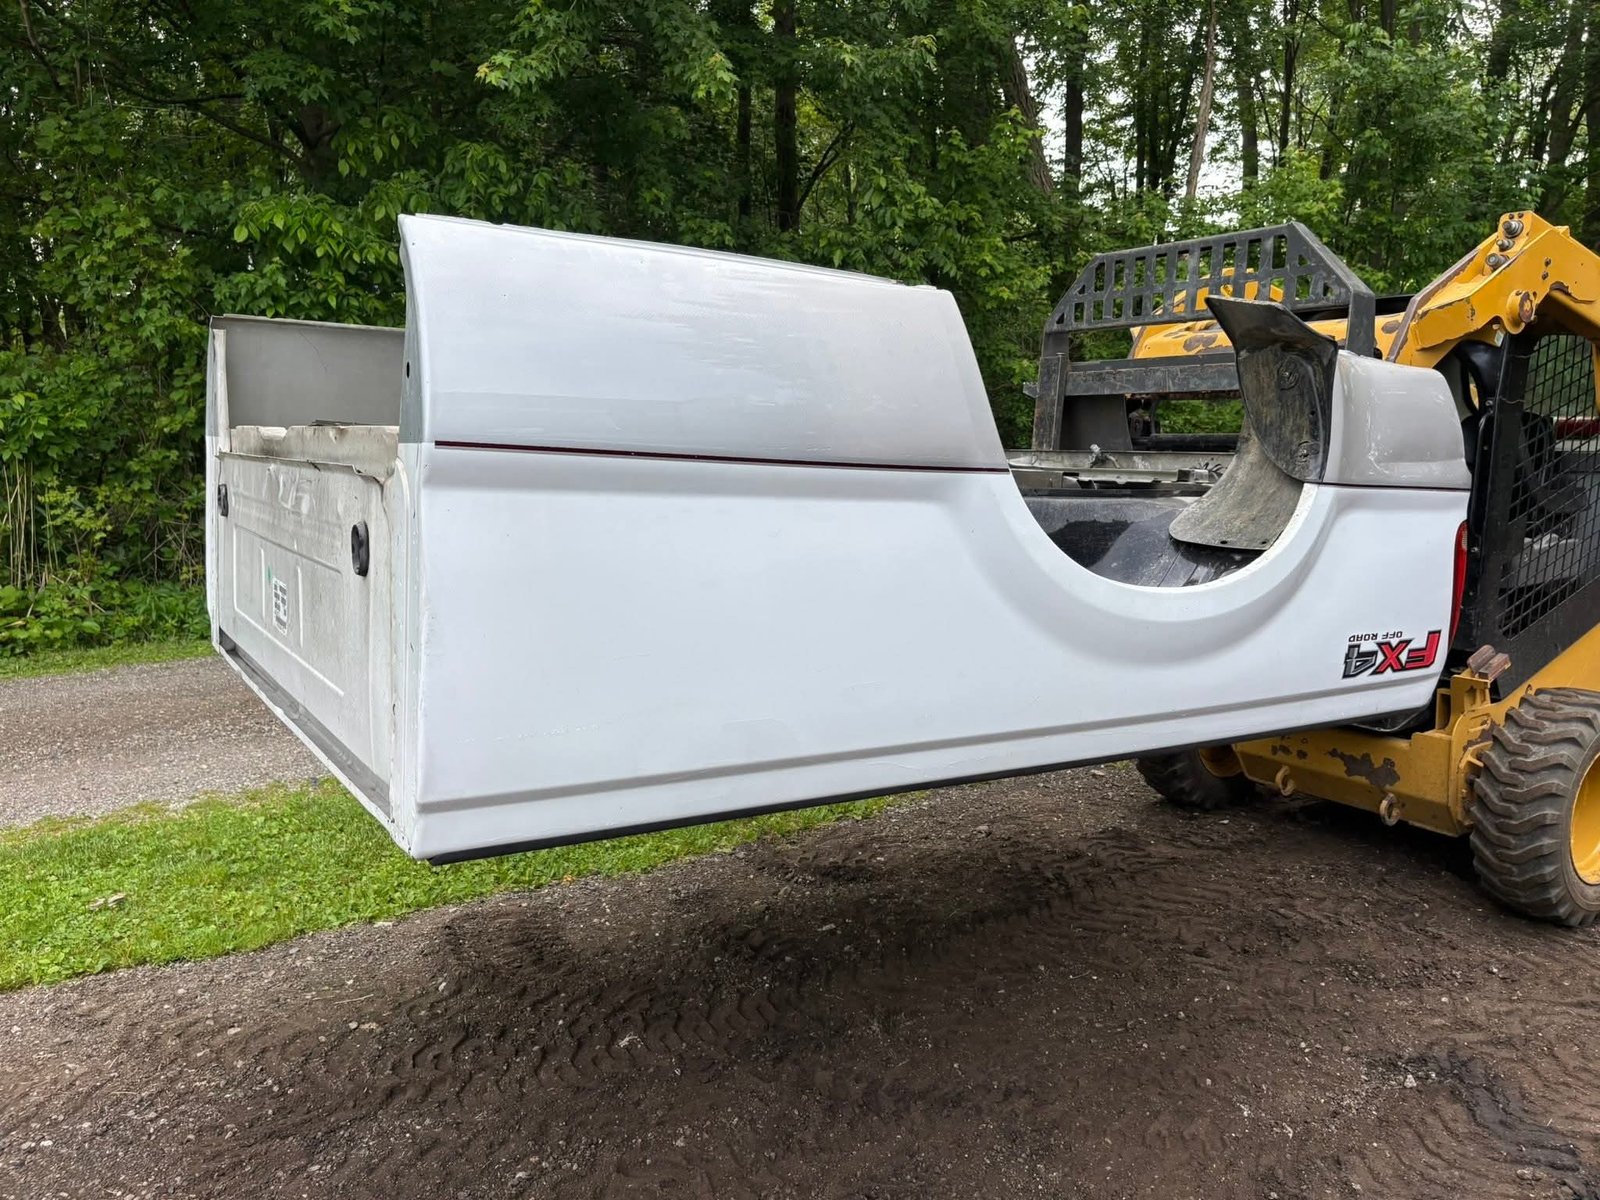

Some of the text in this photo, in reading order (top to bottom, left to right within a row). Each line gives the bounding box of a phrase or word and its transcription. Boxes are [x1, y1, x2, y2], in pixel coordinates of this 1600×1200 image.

[1348, 630, 1403, 643] OFF ROAD
[1342, 629, 1442, 679] FX4
